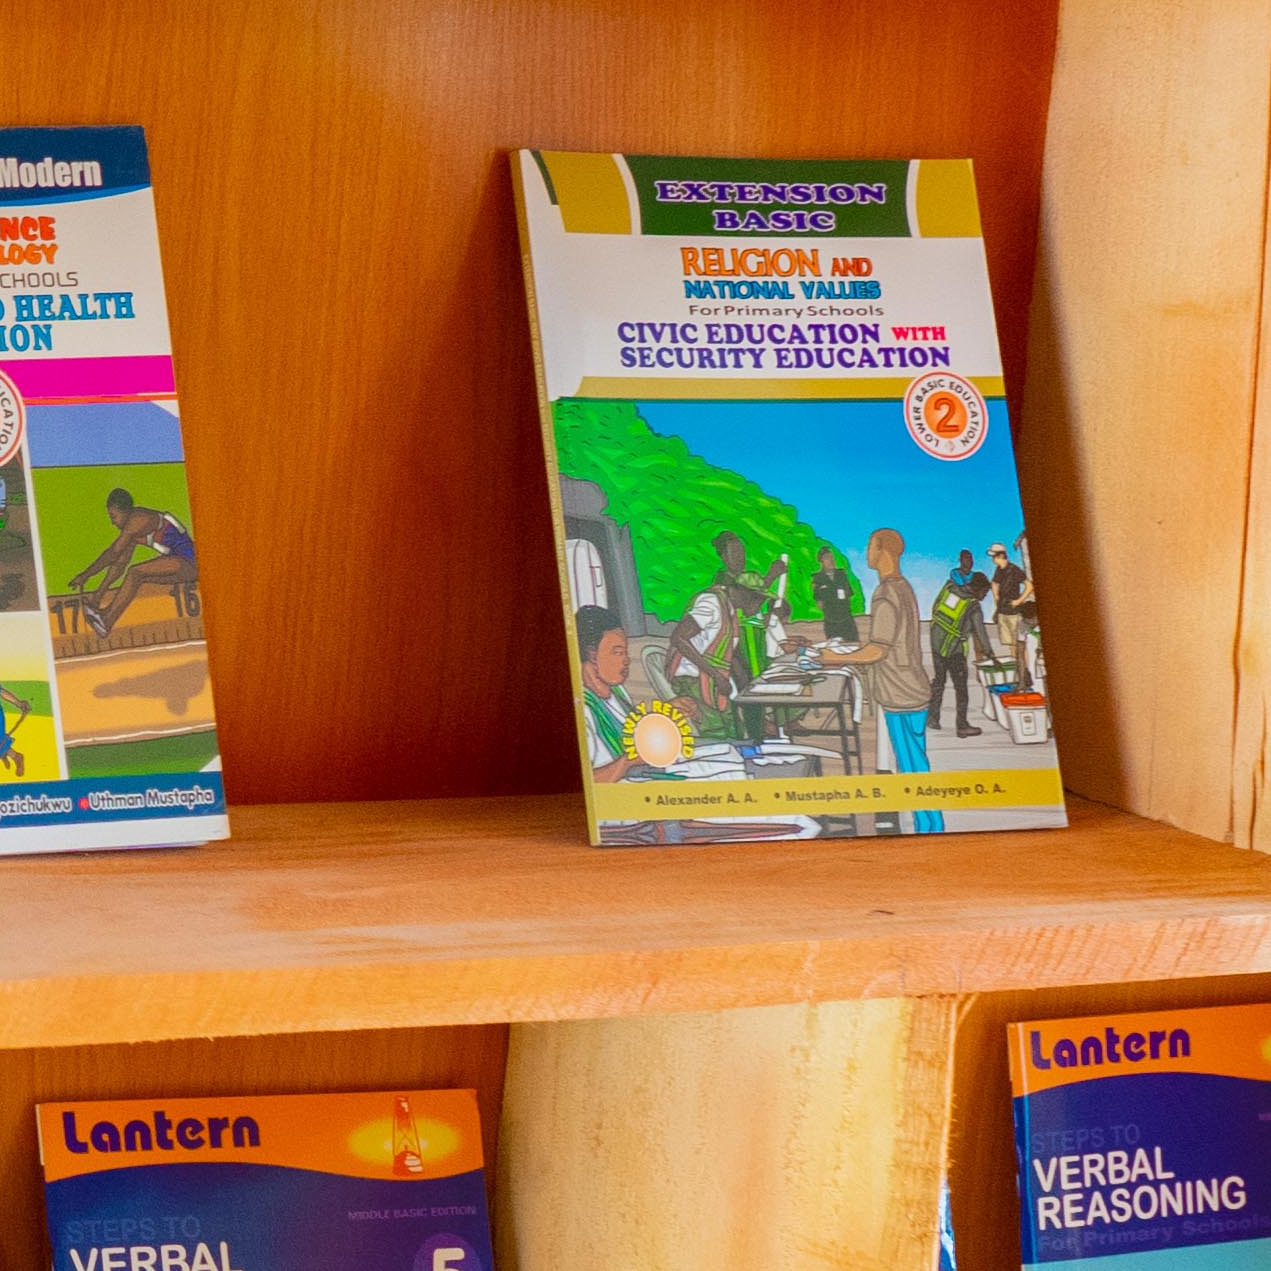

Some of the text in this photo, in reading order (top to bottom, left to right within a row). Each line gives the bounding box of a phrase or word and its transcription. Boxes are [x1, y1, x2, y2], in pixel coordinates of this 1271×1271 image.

[656, 181, 886, 205] EXTENSION
[713, 210, 835, 232] BASIC
[681, 248, 872, 277] RELIGION AND
[685, 280, 881, 300] NATIONAL VALUES
[15, 292, 135, 322] HEALTH
[690, 305, 885, 319] For Primary Schools
[618, 323, 945, 344] CIVIC EDUCATION WITH
[620, 347, 950, 369] SECURITY EDUCATION
[934, 398, 959, 433] 2
[89, 788, 214, 809] Uthman Mustapha
[656, 793, 758, 806] Alexander A. A.
[785, 789, 850, 805] Mustapha
[855, 789, 869, 800] A.
[916, 785, 970, 800] Adeyeye
[992, 783, 1006, 794] A.
[1030, 1027, 1190, 1070] Lantern
[63, 1111, 260, 1154] Lantern
[1033, 1146, 1174, 1192] VERBAL
[1038, 1176, 1247, 1230] REASONING
